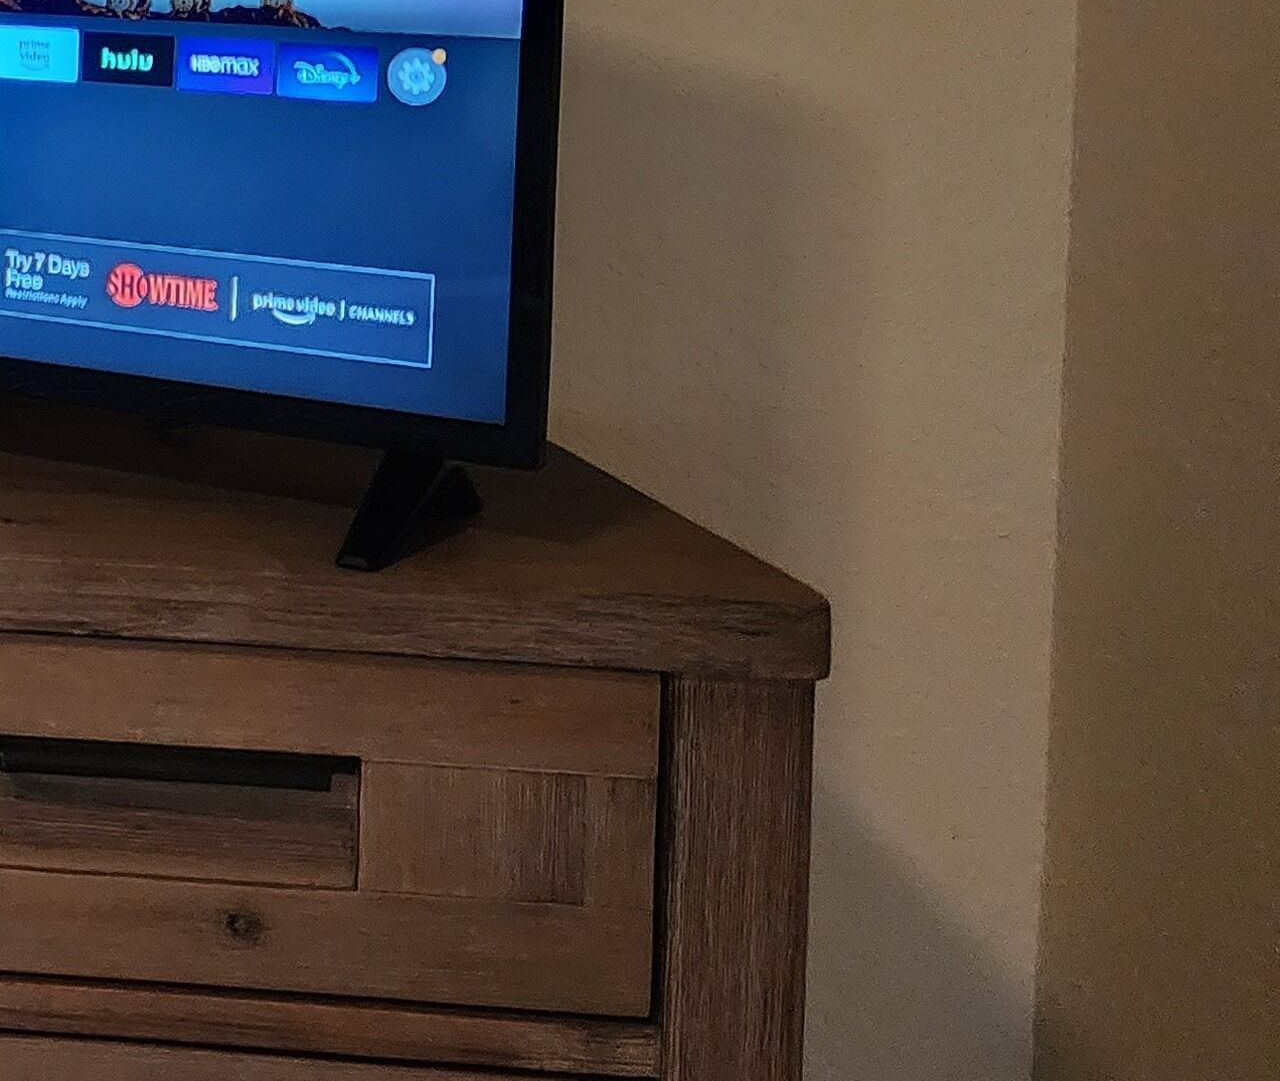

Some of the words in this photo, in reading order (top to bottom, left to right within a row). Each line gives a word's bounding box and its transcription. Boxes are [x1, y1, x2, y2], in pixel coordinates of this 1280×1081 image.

[101, 47, 153, 72] hulu
[5, 249, 32, 271] Try
[34, 252, 46, 270] 7
[48, 254, 90, 279] Days
[5, 270, 43, 290] Free
[106, 263, 218, 311] SHOWTIME
[253, 292, 294, 311] prime
[349, 305, 416, 325] CHANNELS
